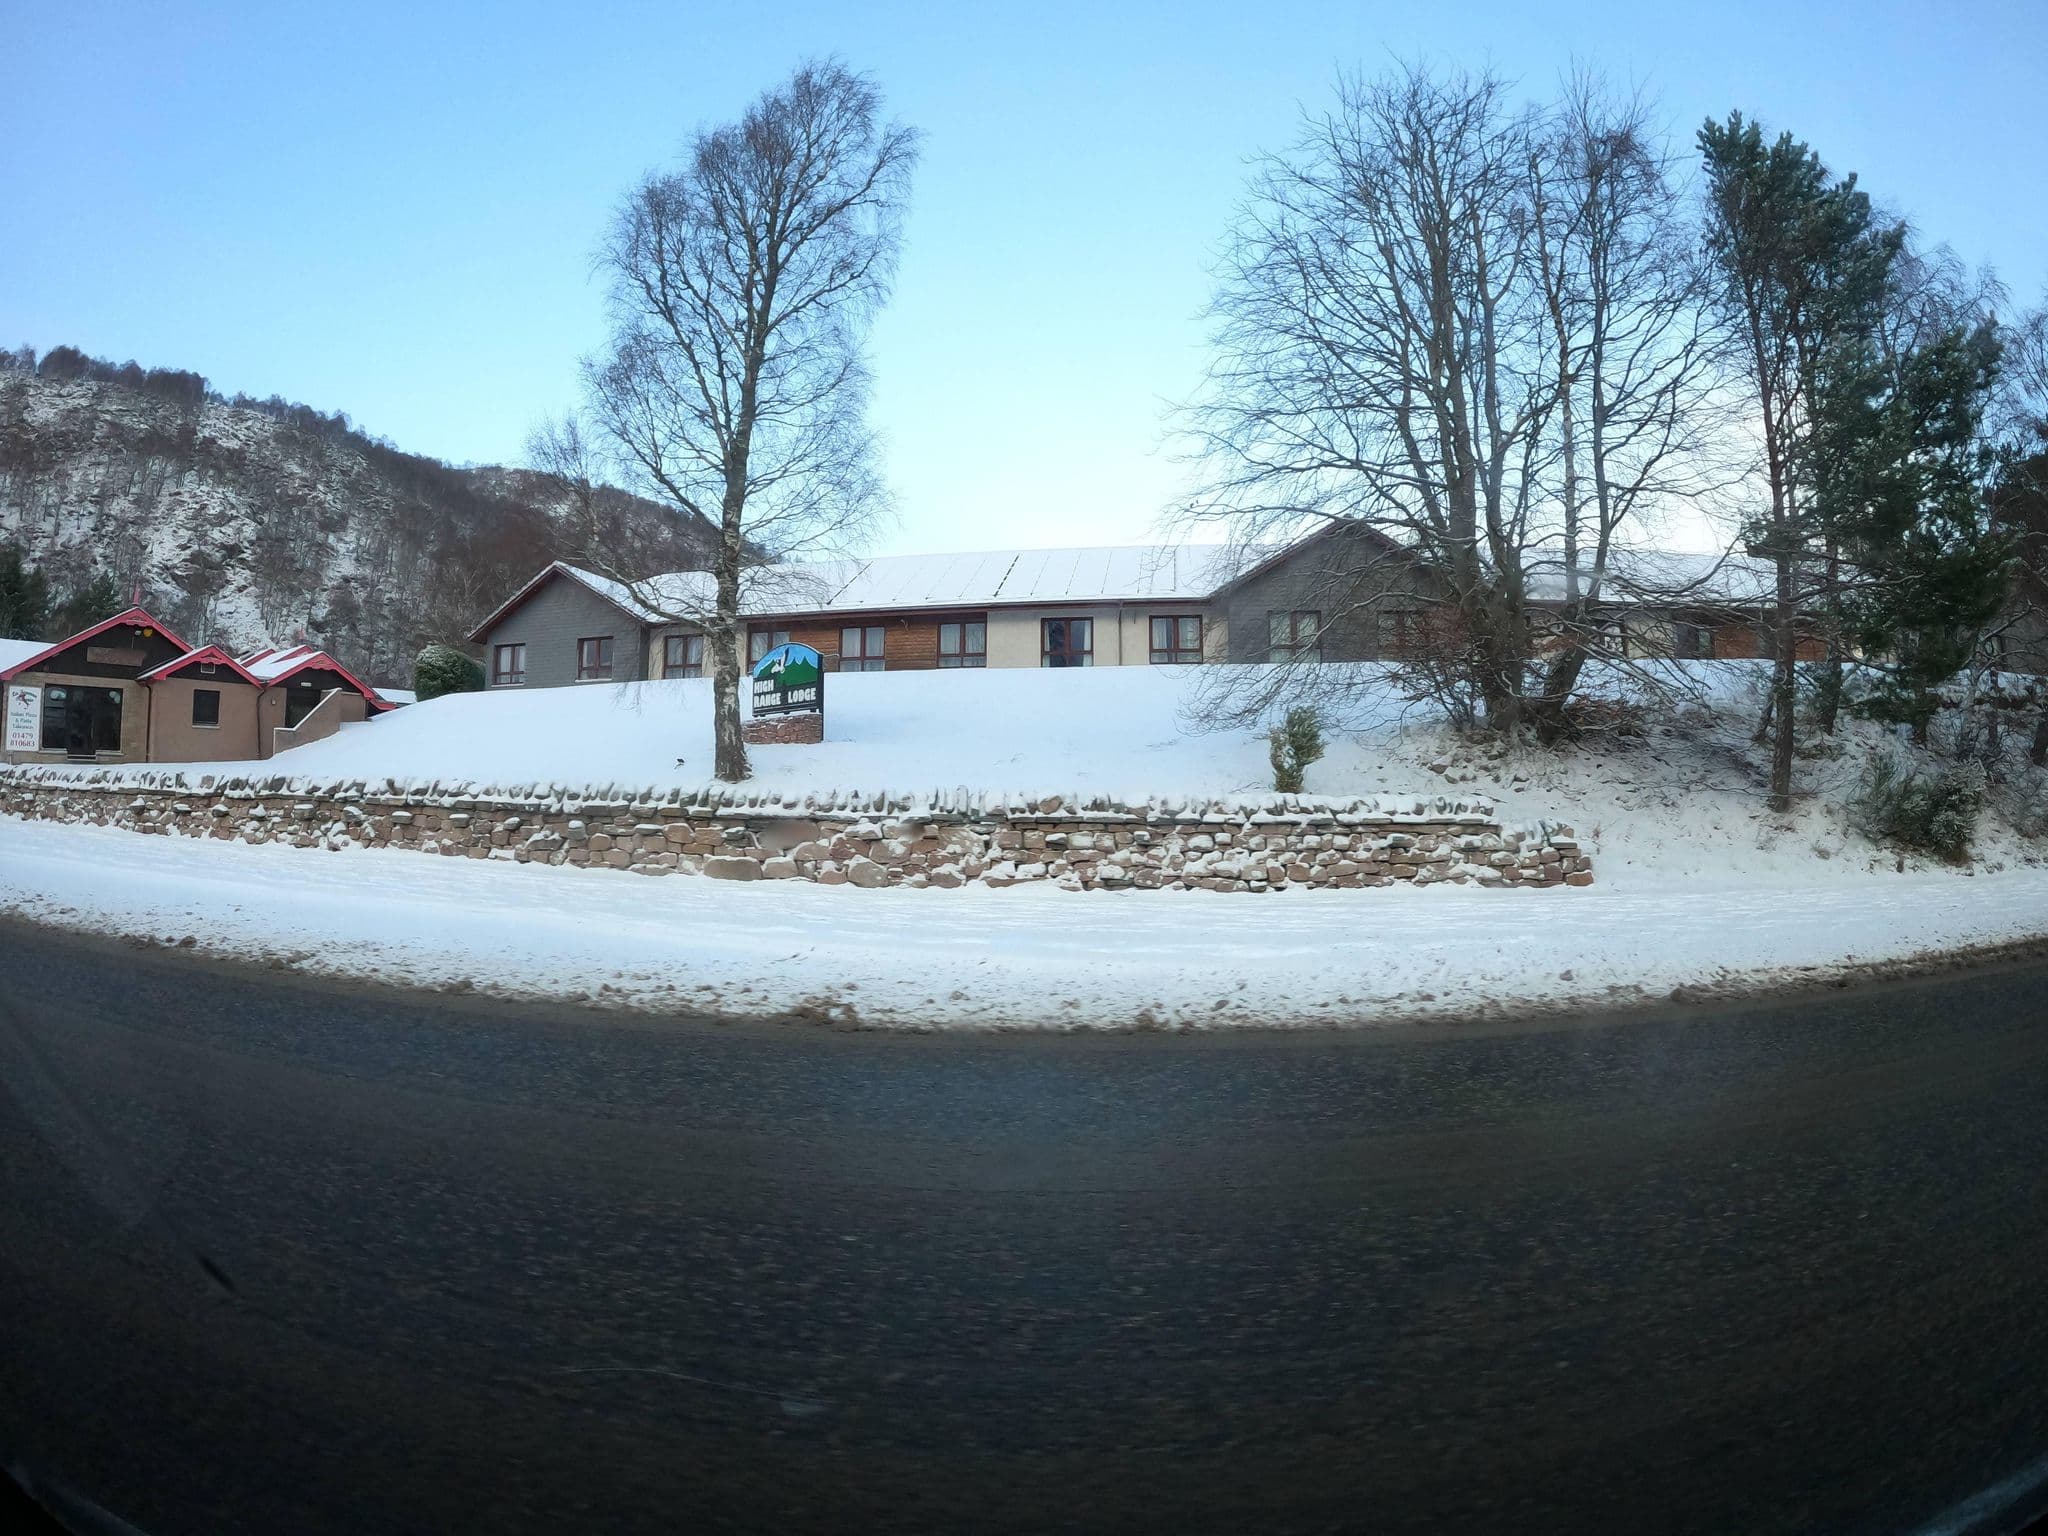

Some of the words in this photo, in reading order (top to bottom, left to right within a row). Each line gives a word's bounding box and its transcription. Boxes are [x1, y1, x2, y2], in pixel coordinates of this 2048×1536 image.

[754, 680, 774, 693] HIGH
[754, 693, 781, 708] RANGE
[788, 688, 816, 703] LODGE
